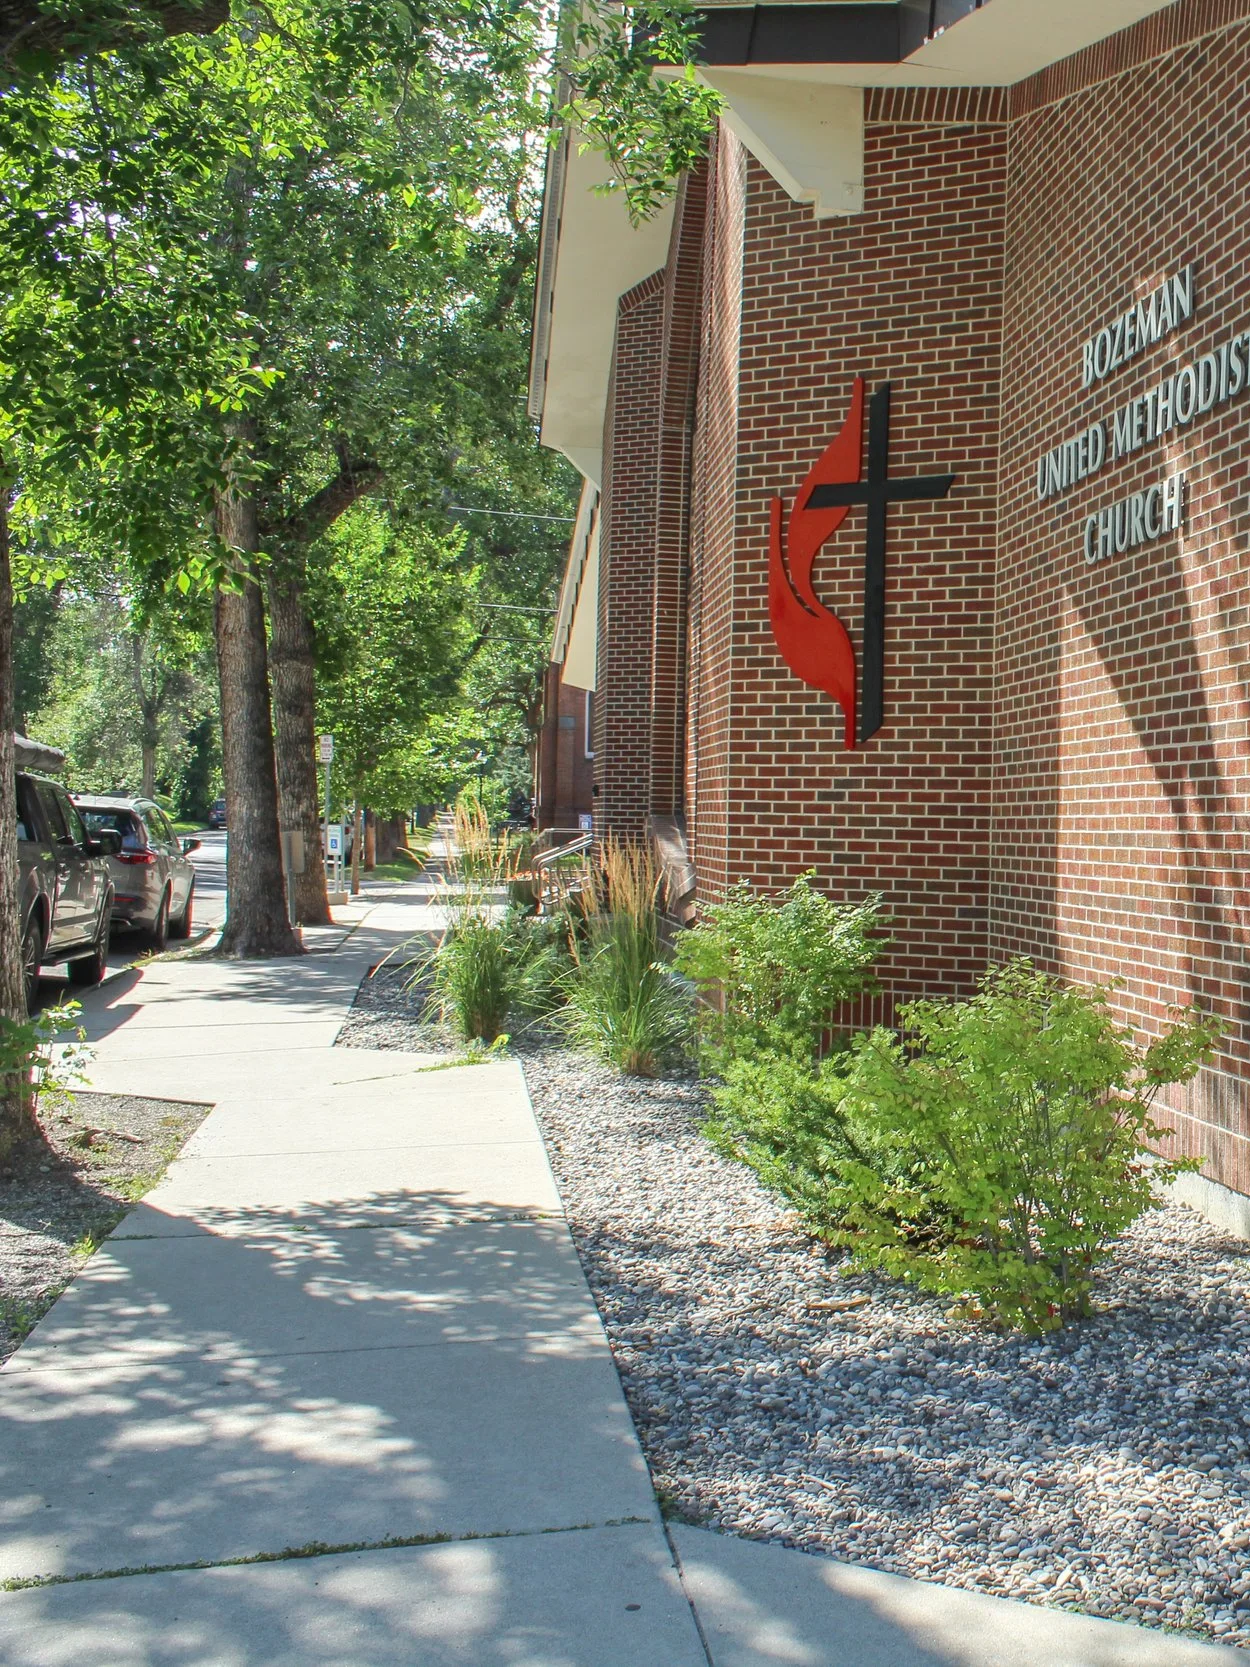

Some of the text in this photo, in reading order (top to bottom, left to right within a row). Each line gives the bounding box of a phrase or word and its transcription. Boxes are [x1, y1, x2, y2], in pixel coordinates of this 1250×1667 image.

[1082, 263, 1193, 388] BOZEMAN
[1037, 421, 1105, 499] UNITED
[1084, 472, 1186, 564] CHURCH
